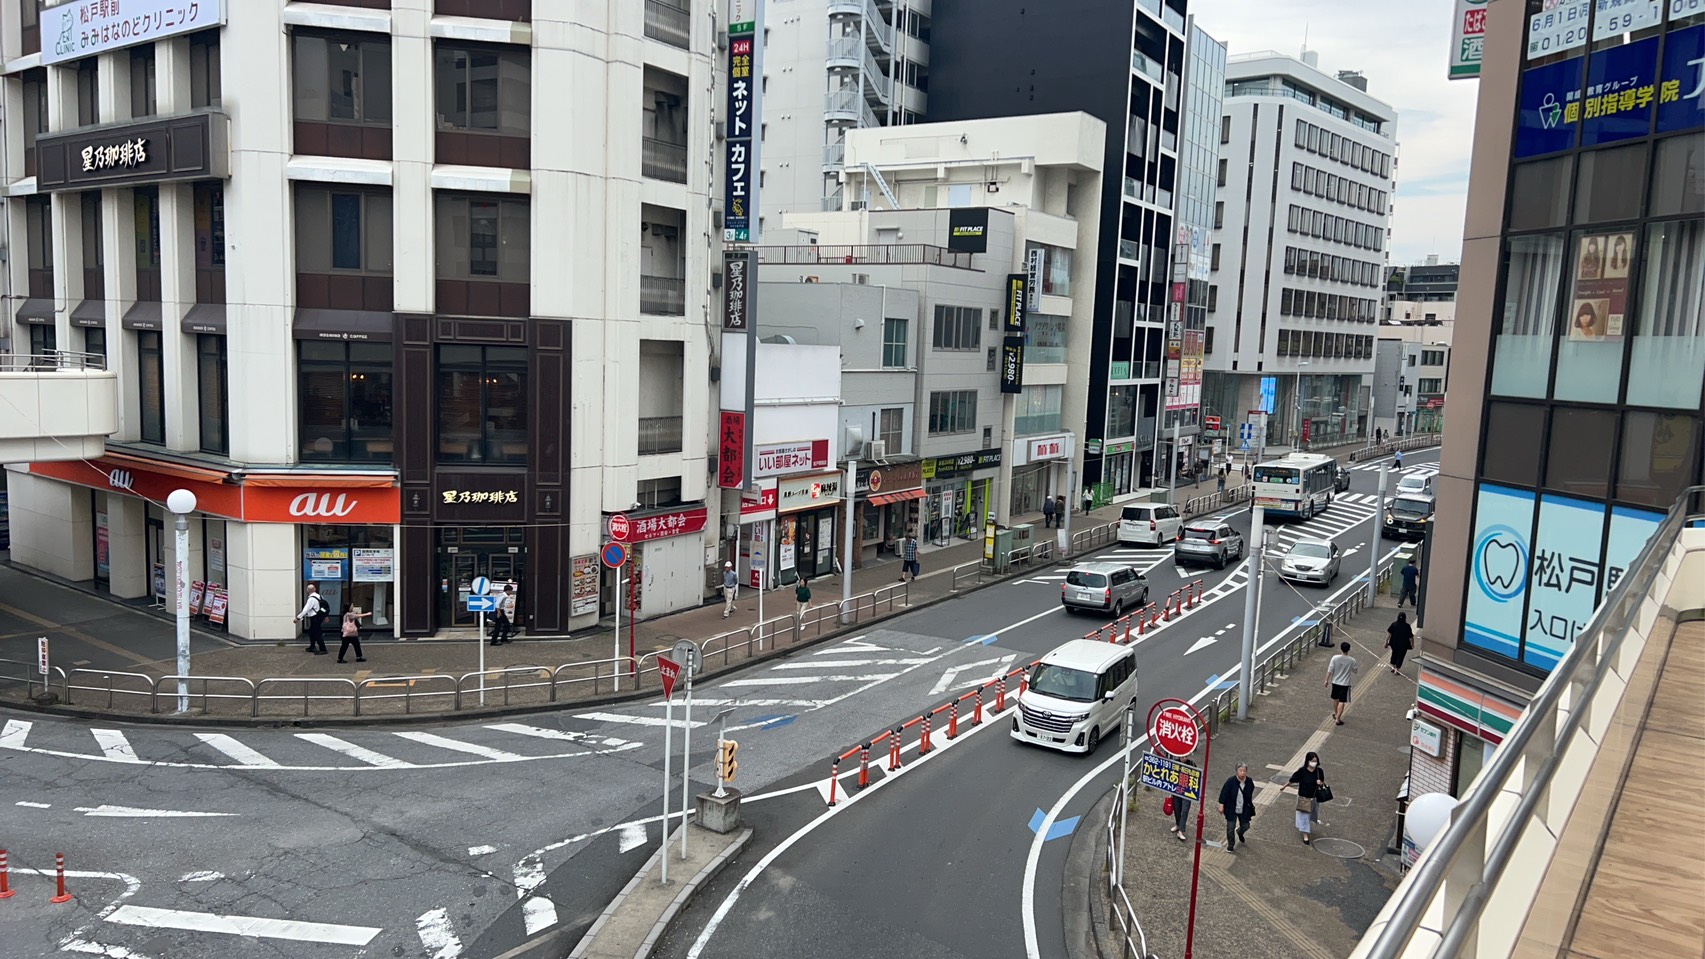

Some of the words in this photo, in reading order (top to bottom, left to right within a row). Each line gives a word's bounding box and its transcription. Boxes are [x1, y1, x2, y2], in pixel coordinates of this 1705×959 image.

[80, 0, 120, 25] 松戸駅前
[80, 1, 199, 49] みみはなのどクリニック
[55, 41, 76, 56] CLINIC
[733, 42, 749, 53] 24H
[1461, 38, 1483, 60] 酒
[732, 54, 750, 67] 完全
[732, 66, 750, 78] 個室
[1564, 79, 1680, 124] 個別指導学院
[731, 80, 748, 196] ネットカフェ
[81, 137, 147, 171] 星乃珈琲店
[739, 230, 748, 240] 4F
[729, 261, 744, 328] 星乃珈琲店
[1014, 302, 1022, 327] PLACE
[721, 426, 737, 484] 大都会
[758, 452, 811, 471] いい部屋ネット
[109, 468, 134, 488] au
[288, 492, 358, 517] au
[442, 490, 518, 504] 星乃珈琲店
[611, 522, 628, 533] 消火栓
[636, 513, 687, 534] 酒場大都会
[660, 664, 676, 679] 止まれ
[1162, 711, 1173, 719] FIRE
[1173, 712, 1192, 724] HYDRANT
[1158, 718, 1195, 746] 消火栓
[1143, 761, 1199, 792] かとれあ眼科
